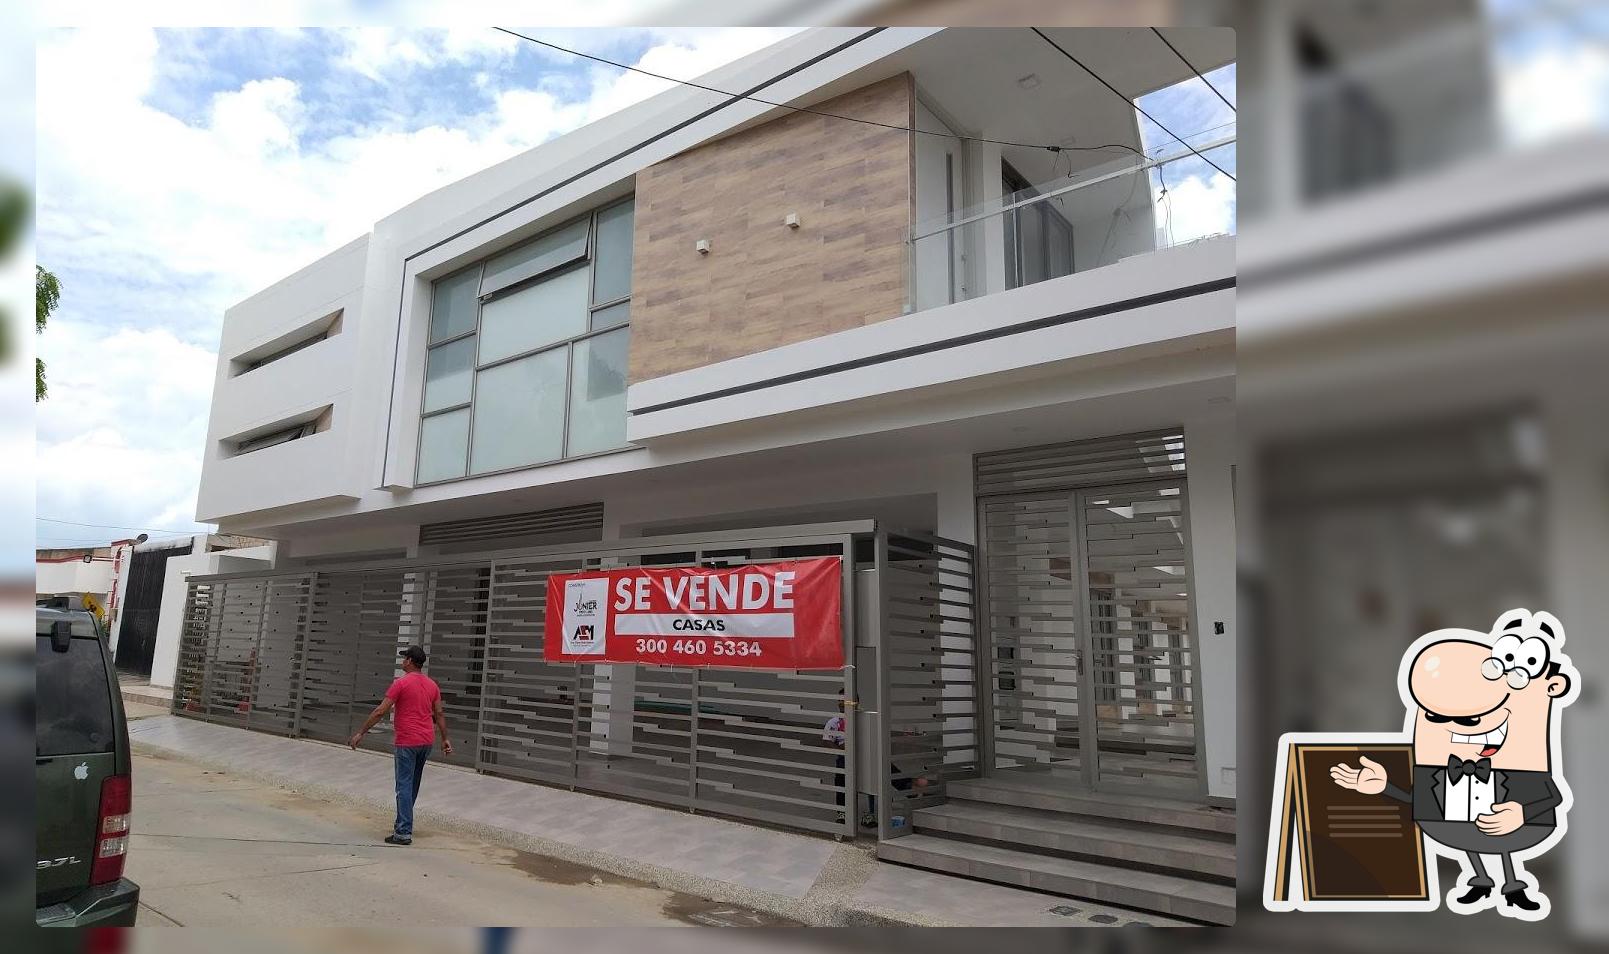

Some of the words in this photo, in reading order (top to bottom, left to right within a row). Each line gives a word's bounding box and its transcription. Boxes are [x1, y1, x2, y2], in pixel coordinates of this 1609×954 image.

[613, 577, 651, 611] SE
[662, 572, 795, 610] VENDE
[672, 619, 725, 631] CASAS
[636, 638, 668, 653] 300
[672, 639, 707, 655] 460
[713, 640, 762, 656] 5334
